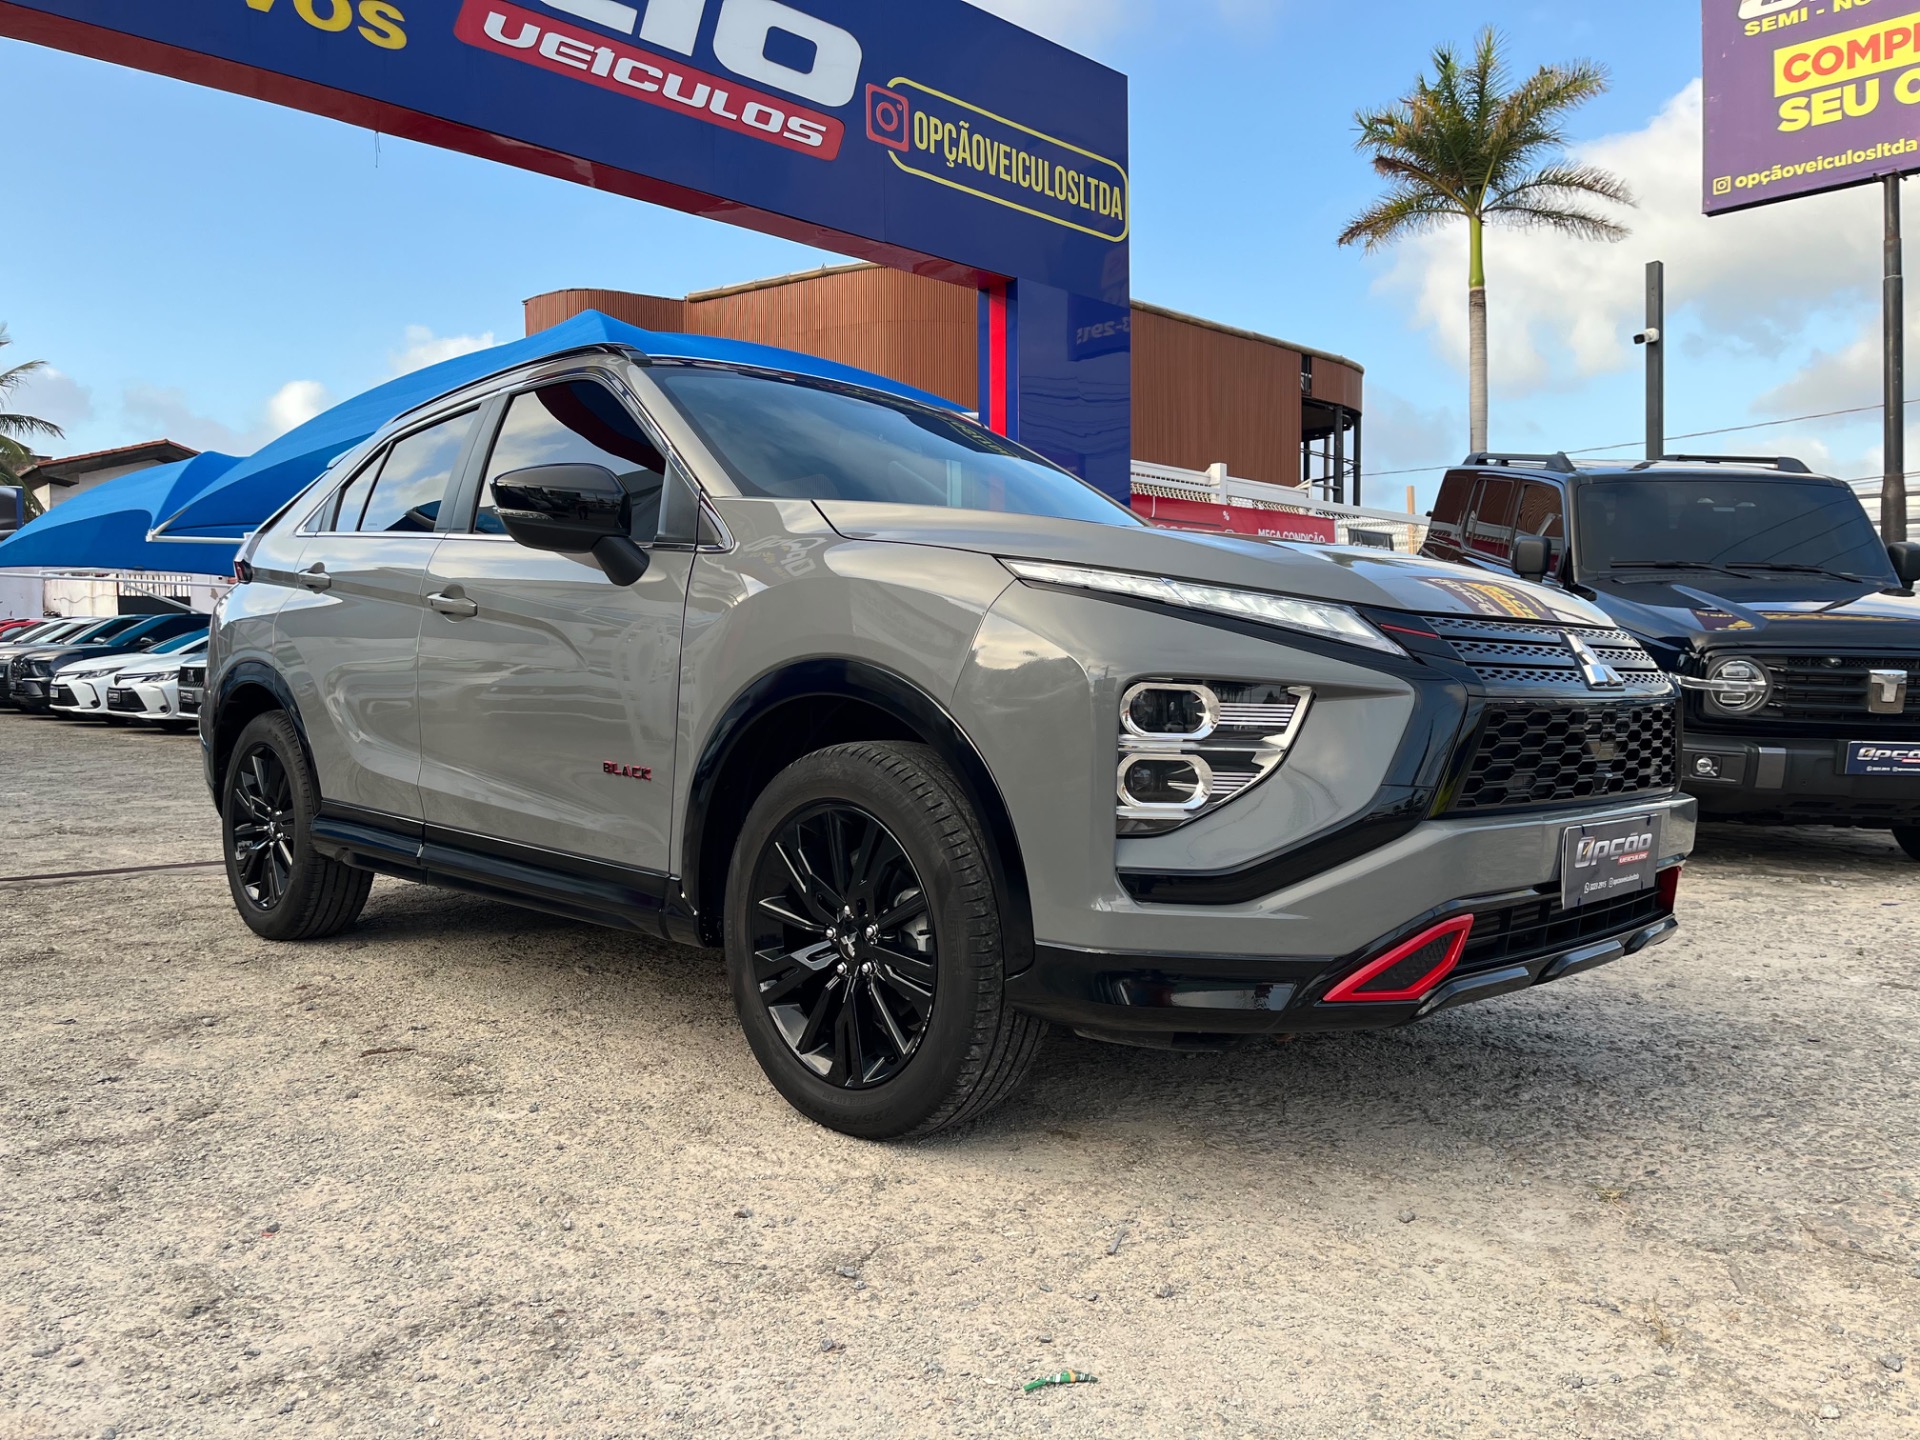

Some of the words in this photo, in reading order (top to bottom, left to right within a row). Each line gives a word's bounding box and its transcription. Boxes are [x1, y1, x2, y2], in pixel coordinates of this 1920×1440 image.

[246, 0, 408, 50] OS
[1744, 7, 1809, 36] SEMI
[1777, 77, 1880, 132] SEU
[913, 111, 1123, 221] OPÇÃOVEICULOSLTDA
[1735, 138, 1918, 189] opçãoveiculosltda
[603, 760, 652, 781] BLACK
